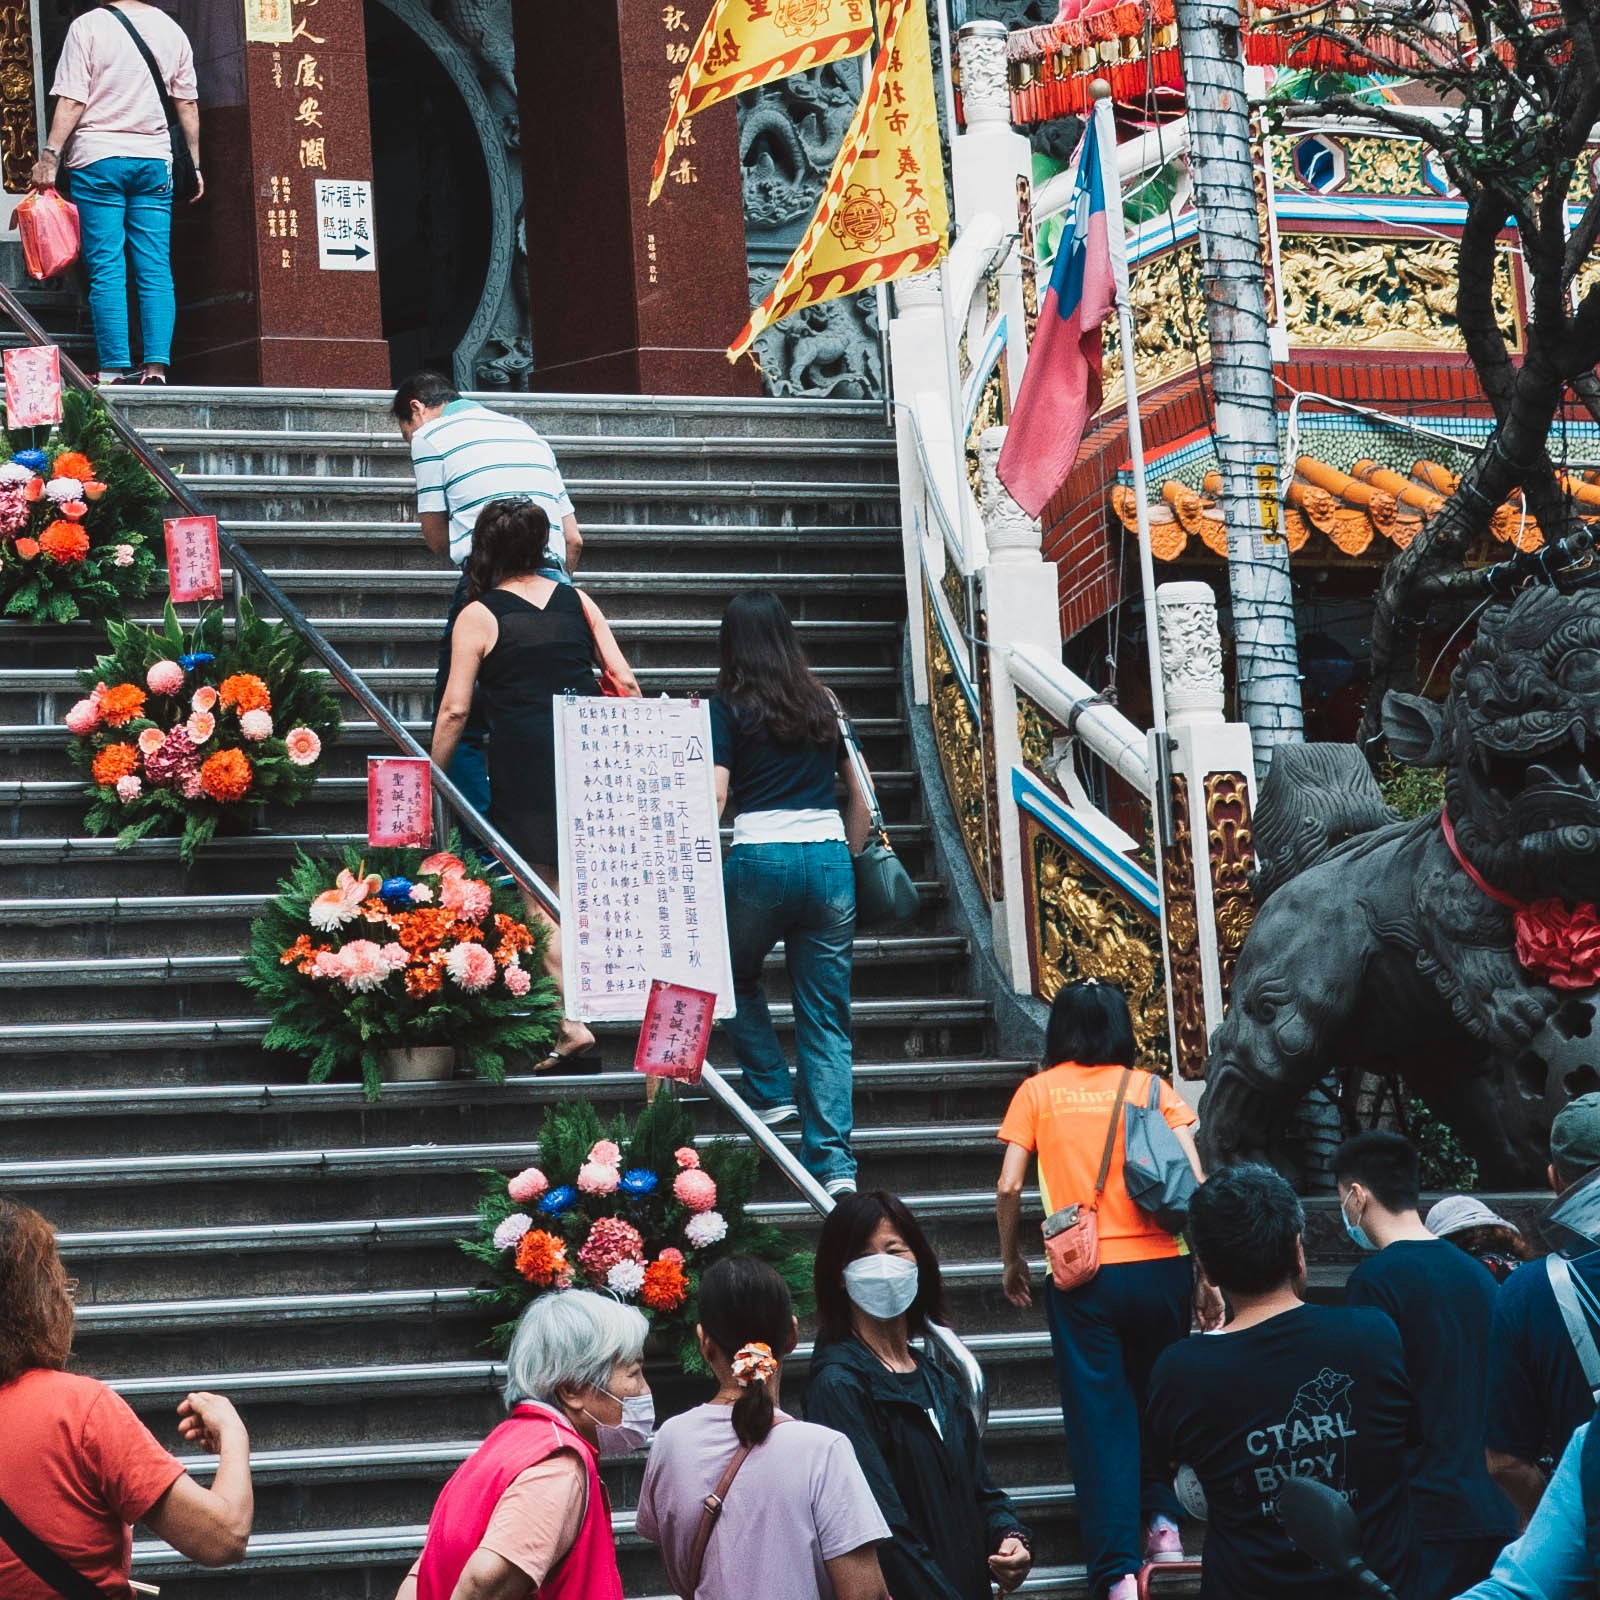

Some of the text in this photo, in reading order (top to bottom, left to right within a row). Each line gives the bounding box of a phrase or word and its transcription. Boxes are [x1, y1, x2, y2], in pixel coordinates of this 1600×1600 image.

[320, 184, 367, 209] 祈福卡
[685, 736, 713, 864] 公 告
[1245, 1409, 1357, 1457] CTARL
